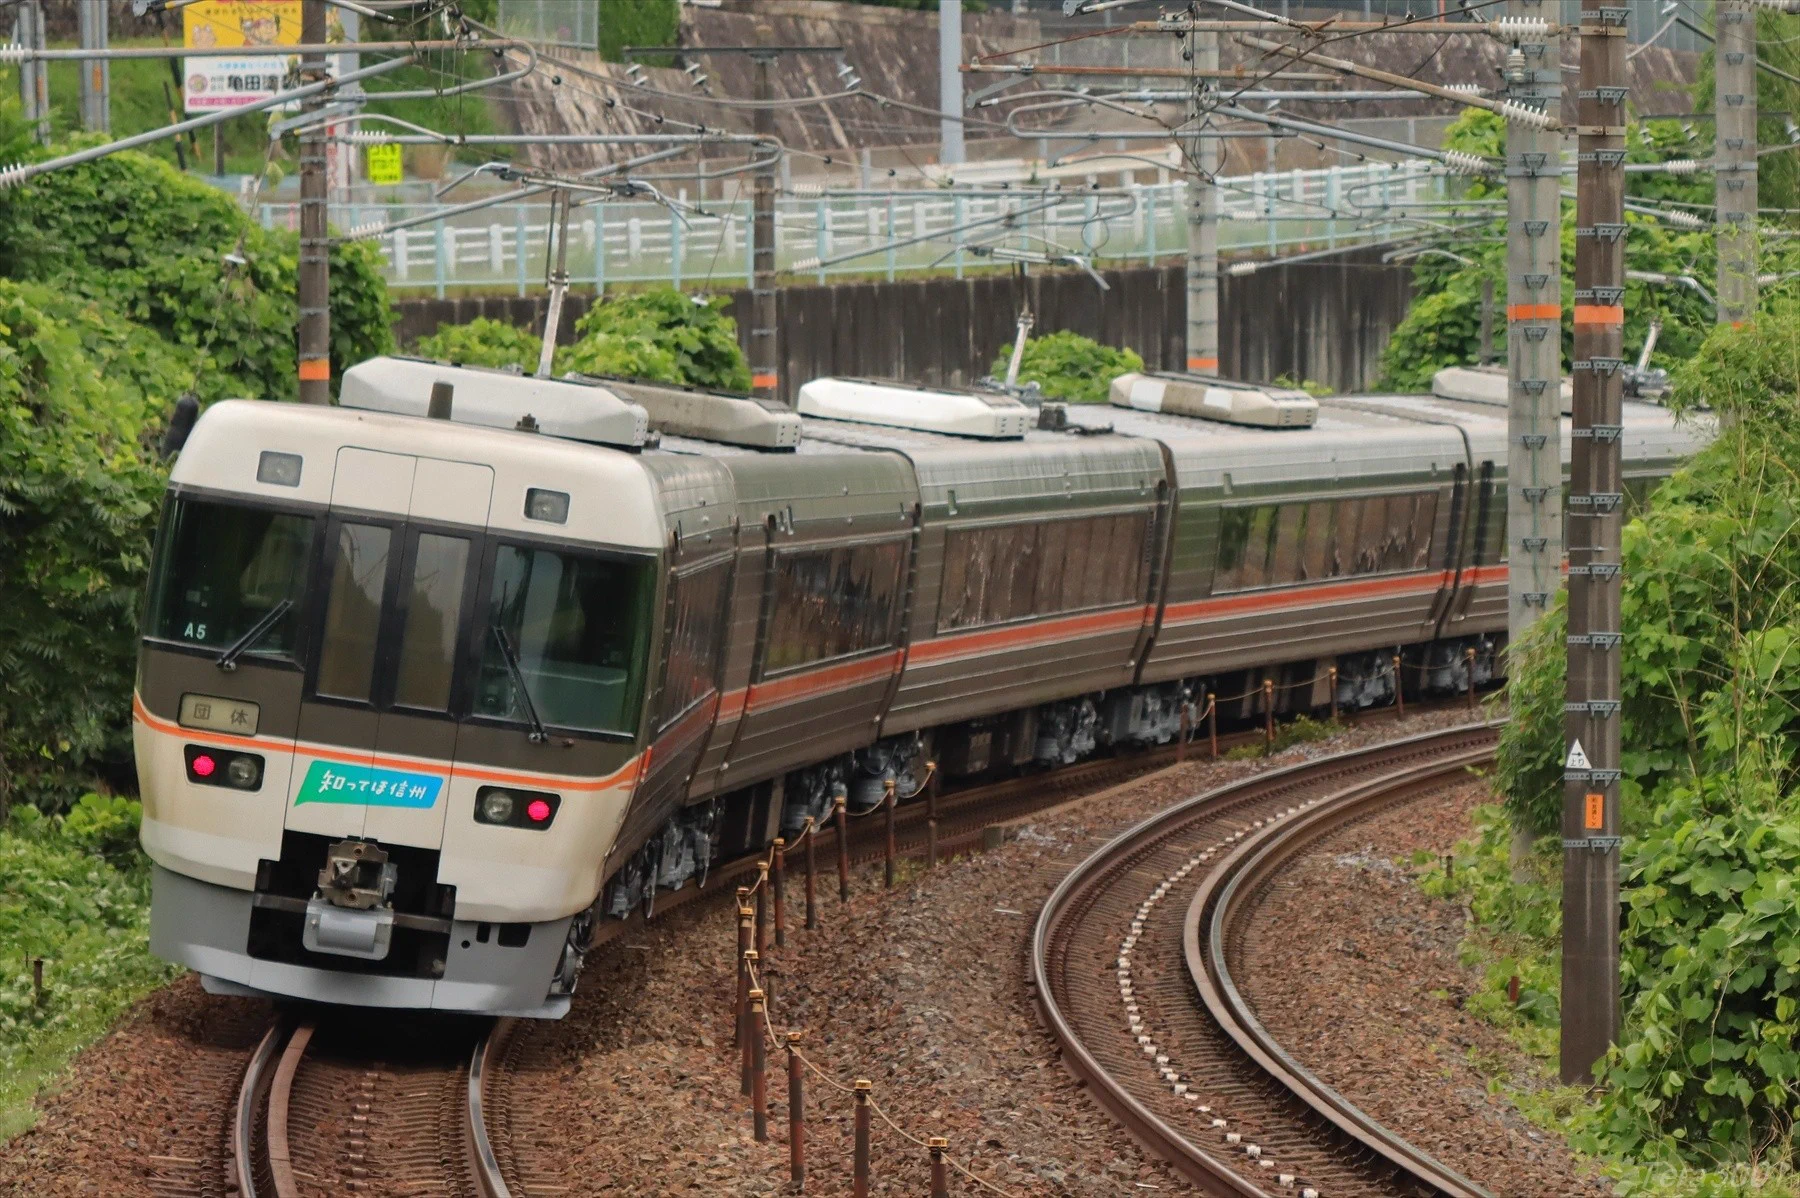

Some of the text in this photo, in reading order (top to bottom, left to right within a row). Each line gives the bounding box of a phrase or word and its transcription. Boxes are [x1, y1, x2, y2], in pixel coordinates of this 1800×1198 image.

[184, 622, 207, 640] A5
[193, 703, 249, 726] 団体
[1570, 758, 1585, 767] 上り
[318, 769, 427, 800] 知ってほ信州
